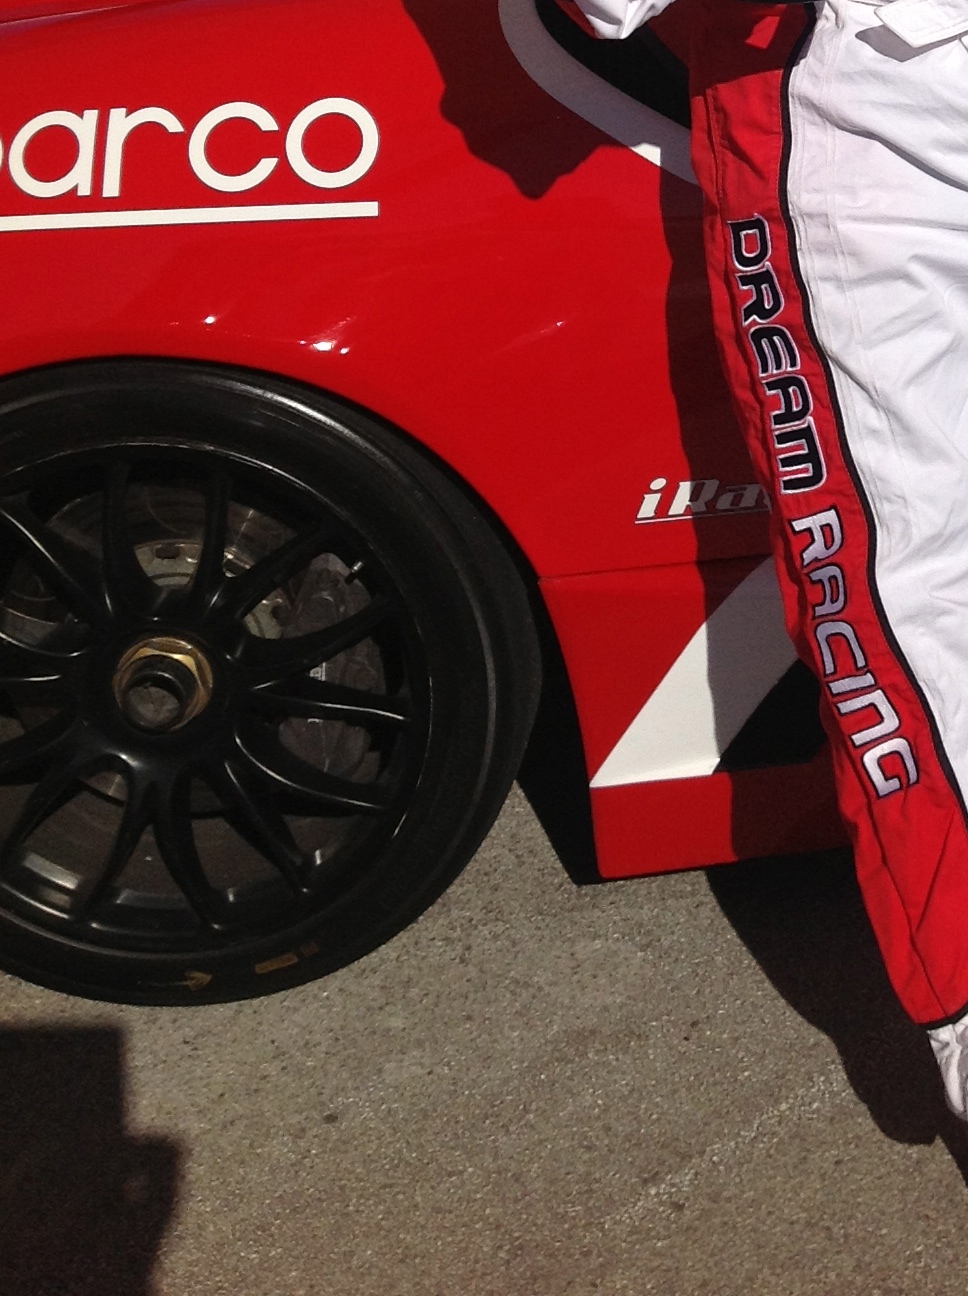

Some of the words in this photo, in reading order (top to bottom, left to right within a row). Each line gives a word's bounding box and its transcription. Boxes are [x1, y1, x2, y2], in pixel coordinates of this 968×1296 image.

[0, 96, 380, 198] arco
[727, 213, 828, 494] DREAM
[790, 506, 918, 800] RACING
